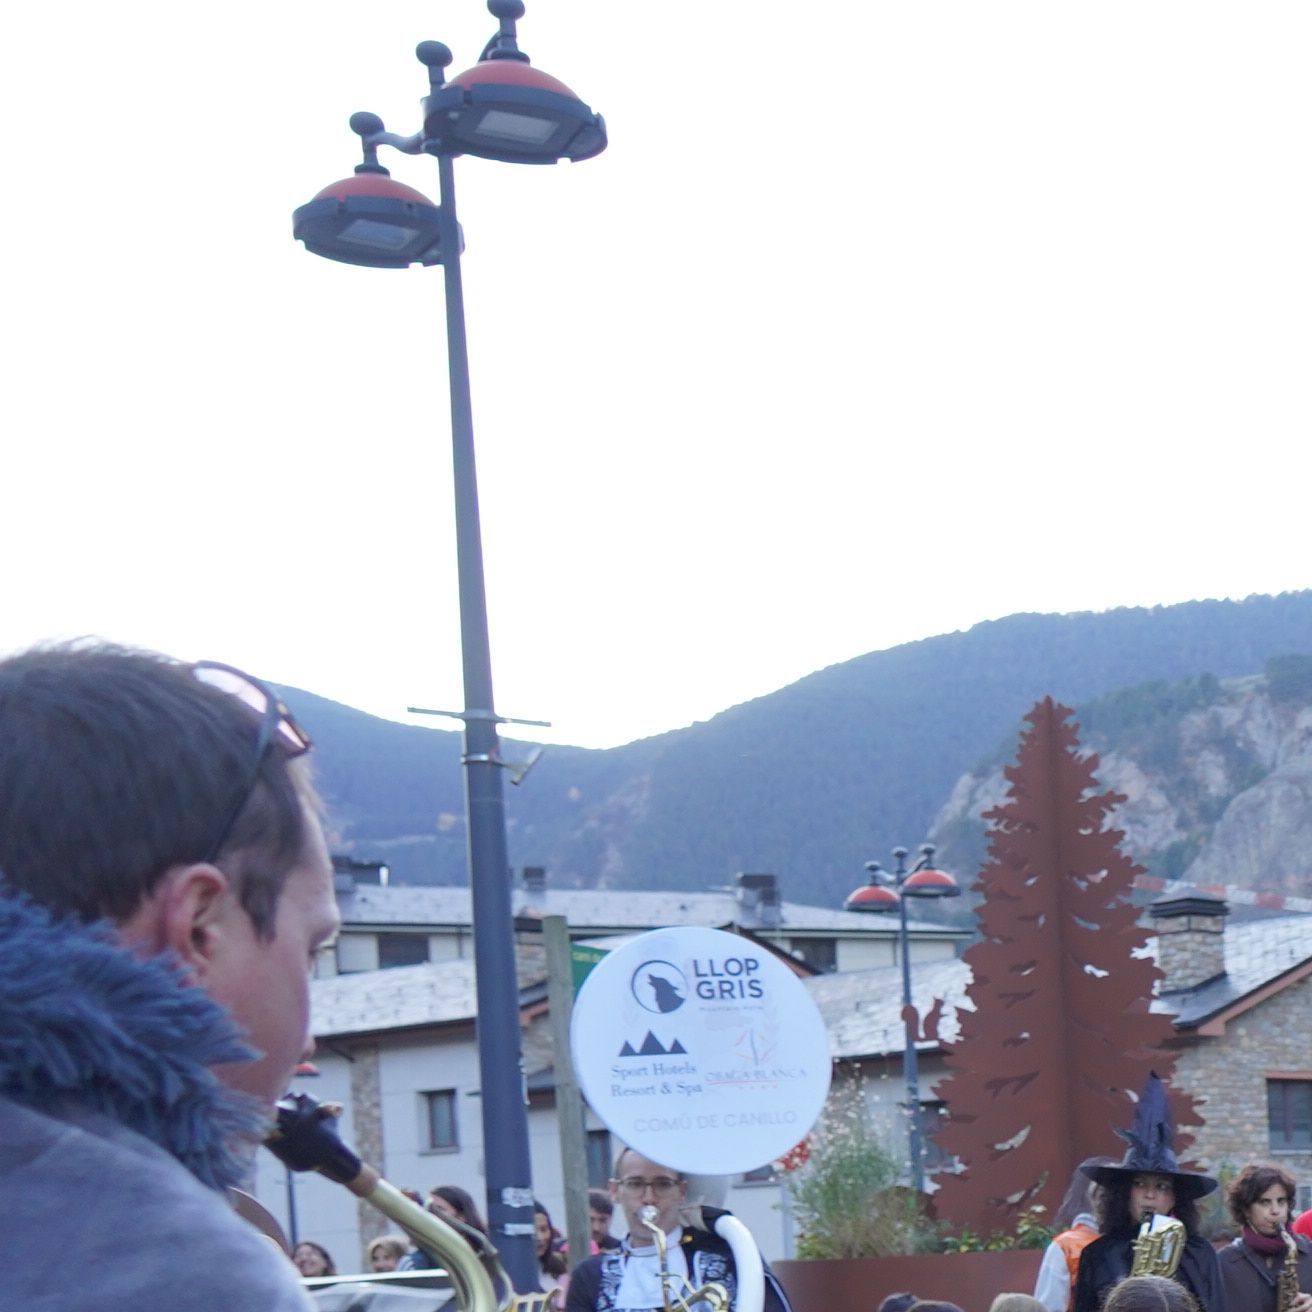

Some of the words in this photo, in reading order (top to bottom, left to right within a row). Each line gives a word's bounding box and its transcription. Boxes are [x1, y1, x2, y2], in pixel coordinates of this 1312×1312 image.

[692, 957, 760, 978] LLOP
[695, 978, 764, 1000] GRIS
[611, 1064, 650, 1081] Sport
[653, 1061, 697, 1076] Hotels
[610, 1083, 655, 1098] Resort
[659, 1081, 672, 1094] &
[675, 1080, 703, 1097] Spa
[633, 1109, 693, 1132] COMÚ
[696, 1113, 718, 1129] DE
[723, 1109, 798, 1127] CANILLO
